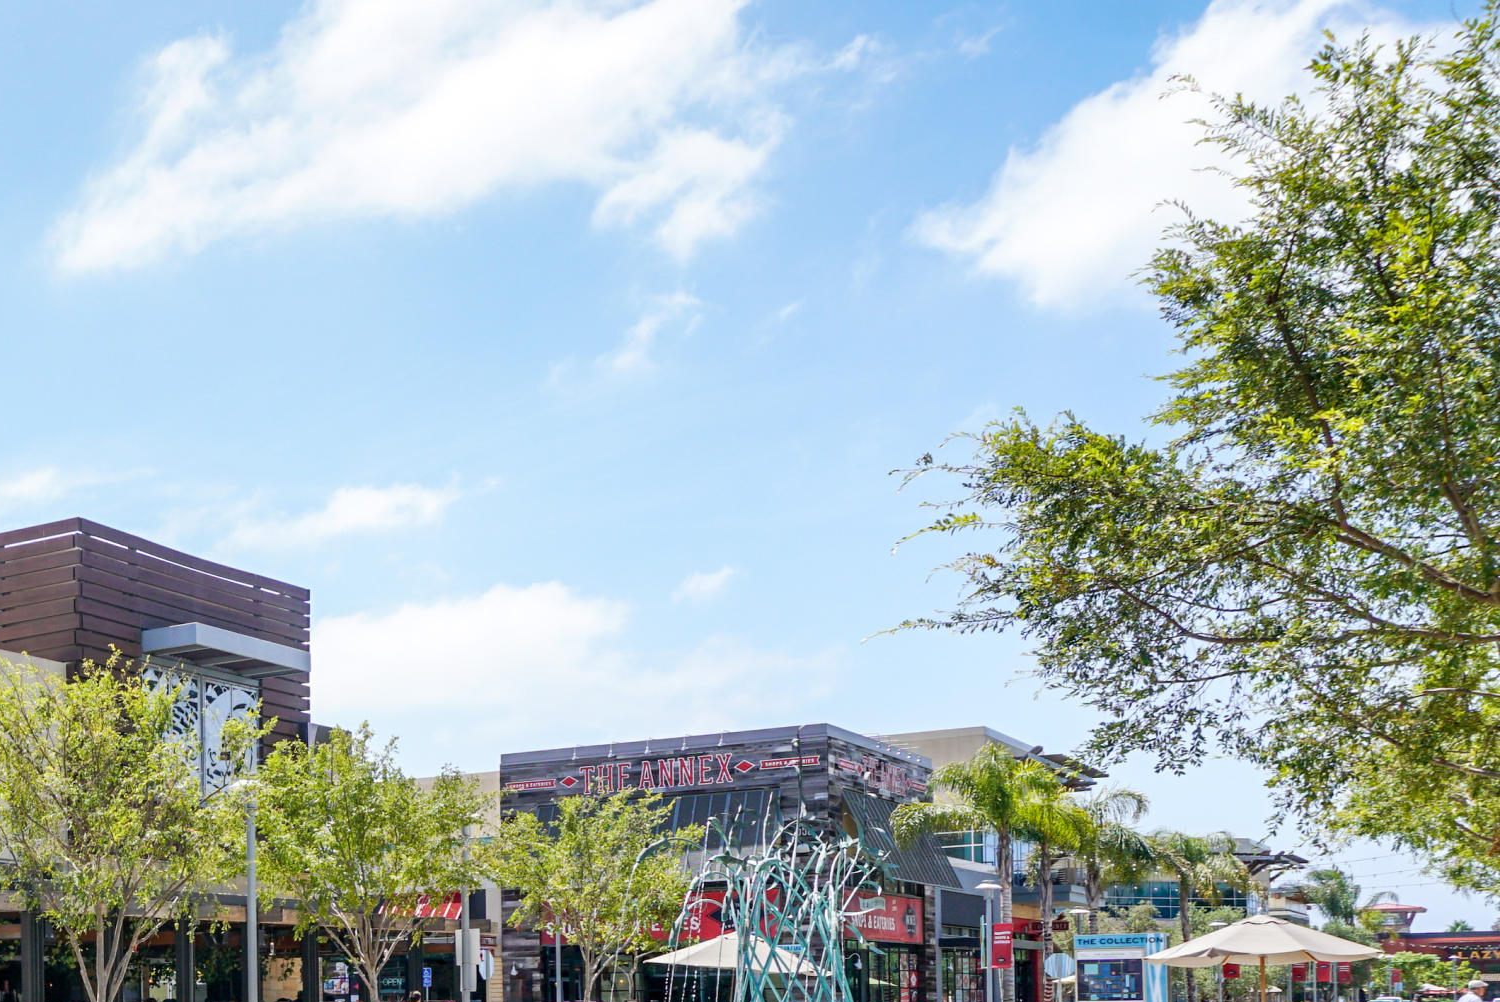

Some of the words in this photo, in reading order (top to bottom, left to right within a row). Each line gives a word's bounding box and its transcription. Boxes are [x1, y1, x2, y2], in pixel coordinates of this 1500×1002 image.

[579, 762, 632, 795] THE
[638, 753, 733, 790] ANNEX
[1099, 936, 1164, 945] COLLECTION
[1457, 950, 1500, 960] LAZY
[382, 978, 402, 986] OPEN
